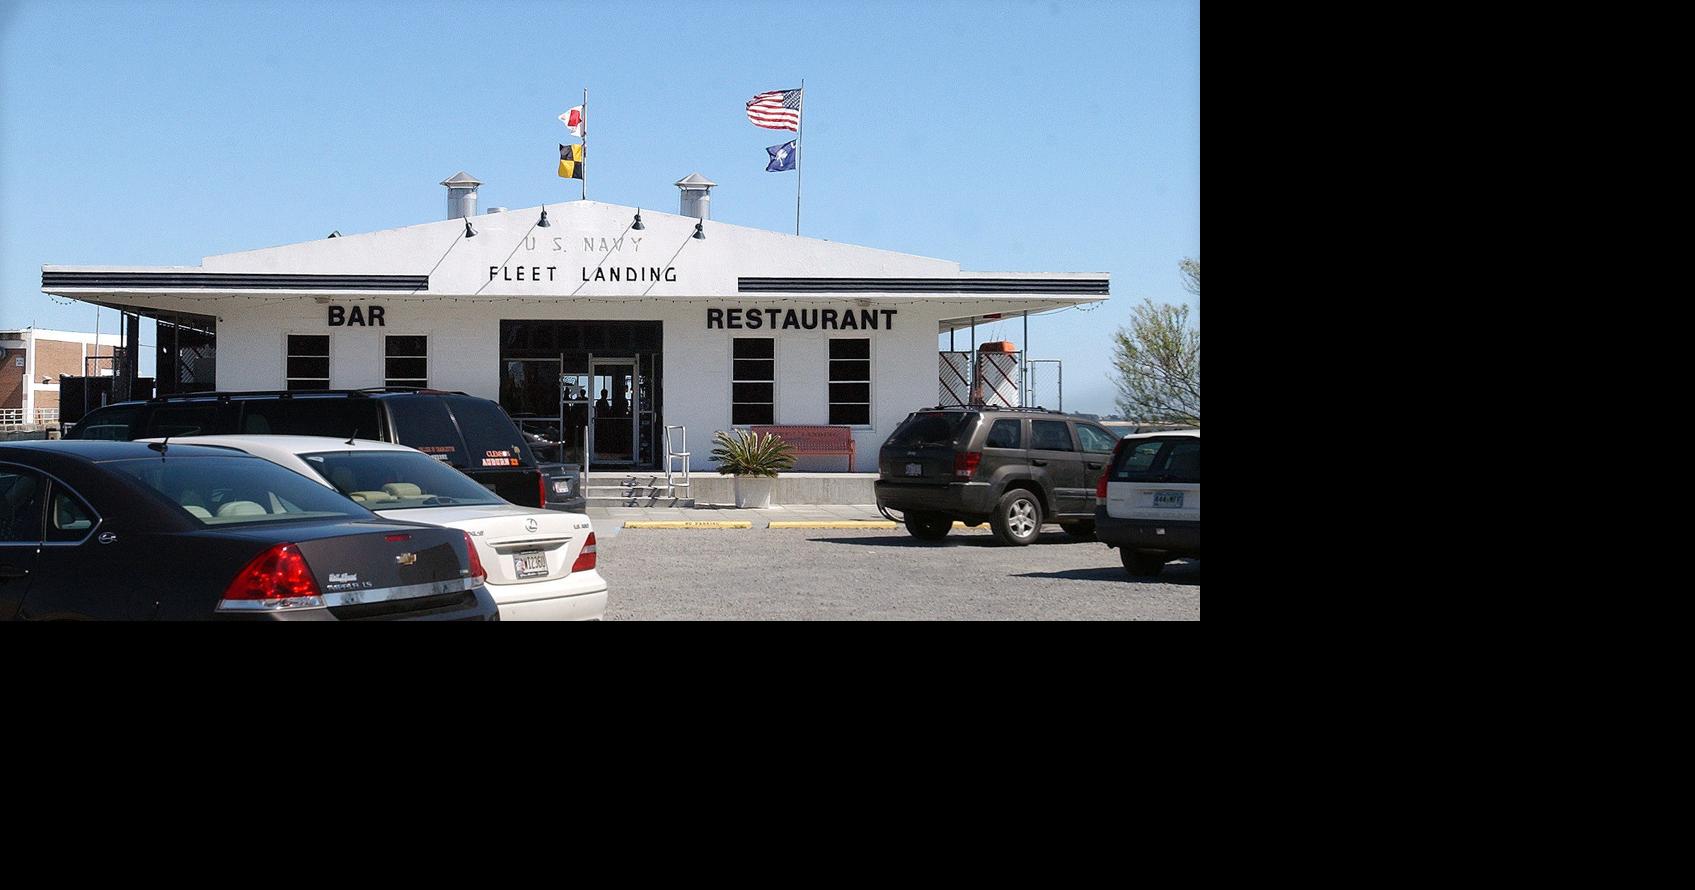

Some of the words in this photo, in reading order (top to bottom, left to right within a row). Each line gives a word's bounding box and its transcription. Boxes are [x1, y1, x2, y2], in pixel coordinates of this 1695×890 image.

[584, 237, 643, 252] NAVY
[489, 266, 557, 282] FLEET
[582, 266, 677, 282] LANDING
[328, 305, 386, 327] BAR
[707, 308, 898, 330] RESTAURANT
